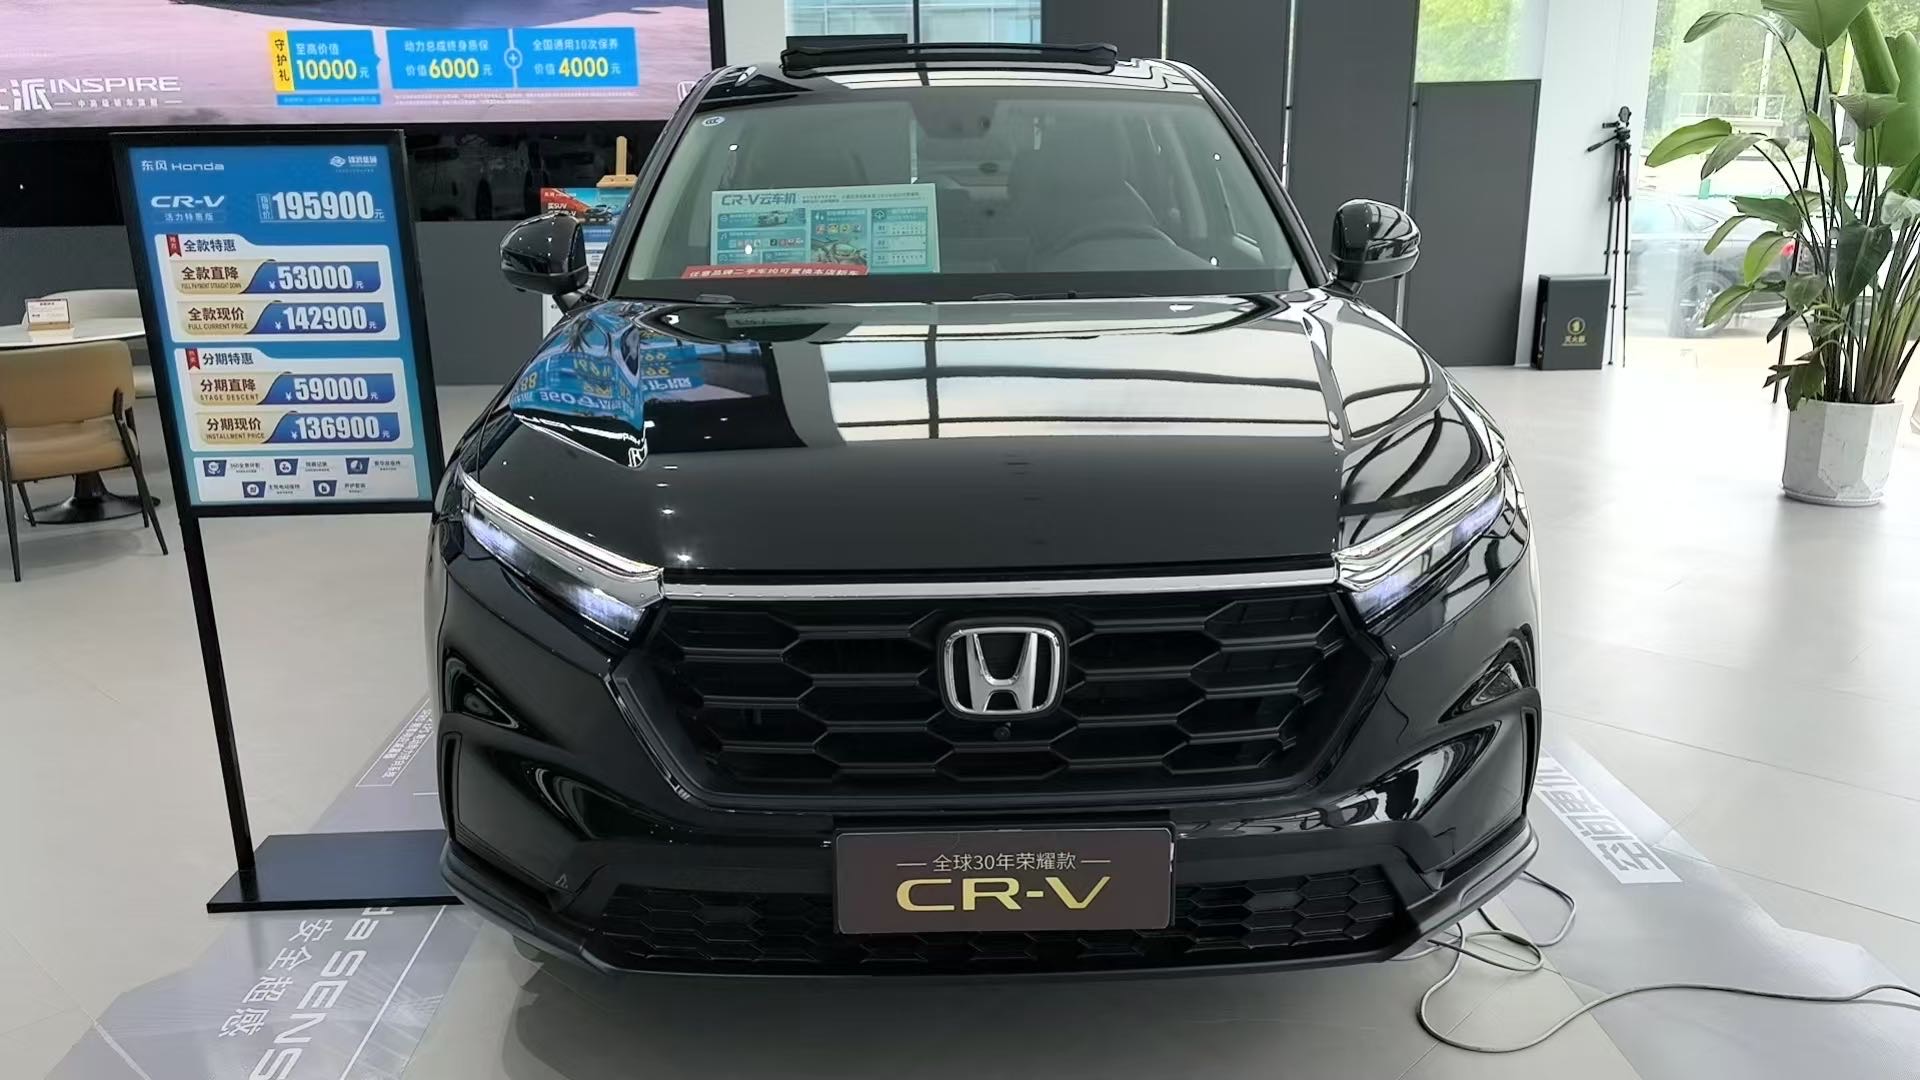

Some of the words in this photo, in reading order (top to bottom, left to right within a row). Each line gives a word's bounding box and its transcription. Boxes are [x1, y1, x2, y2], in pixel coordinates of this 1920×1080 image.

[295, 43, 340, 55] 至高价值
[533, 38, 619, 51] 全国通用10次保养
[274, 39, 290, 82] 守护礼
[0, 78, 52, 111] 派
[50, 76, 182, 94] INSPIRE
[141, 160, 168, 172] 东风
[171, 162, 225, 172] Honda
[151, 195, 225, 208] CR-V
[183, 239, 237, 253] 全款特惠
[181, 266, 239, 280] 全款直降
[188, 307, 245, 321] 全款现价
[202, 352, 254, 366] 分期特惠
[200, 378, 256, 392] 分期直降
[206, 417, 262, 431] 分期现价
[932, 852, 1077, 872] 全球30年荣耀款
[896, 876, 1111, 911] CR-V
[218, 919, 334, 1038] 安全超感
